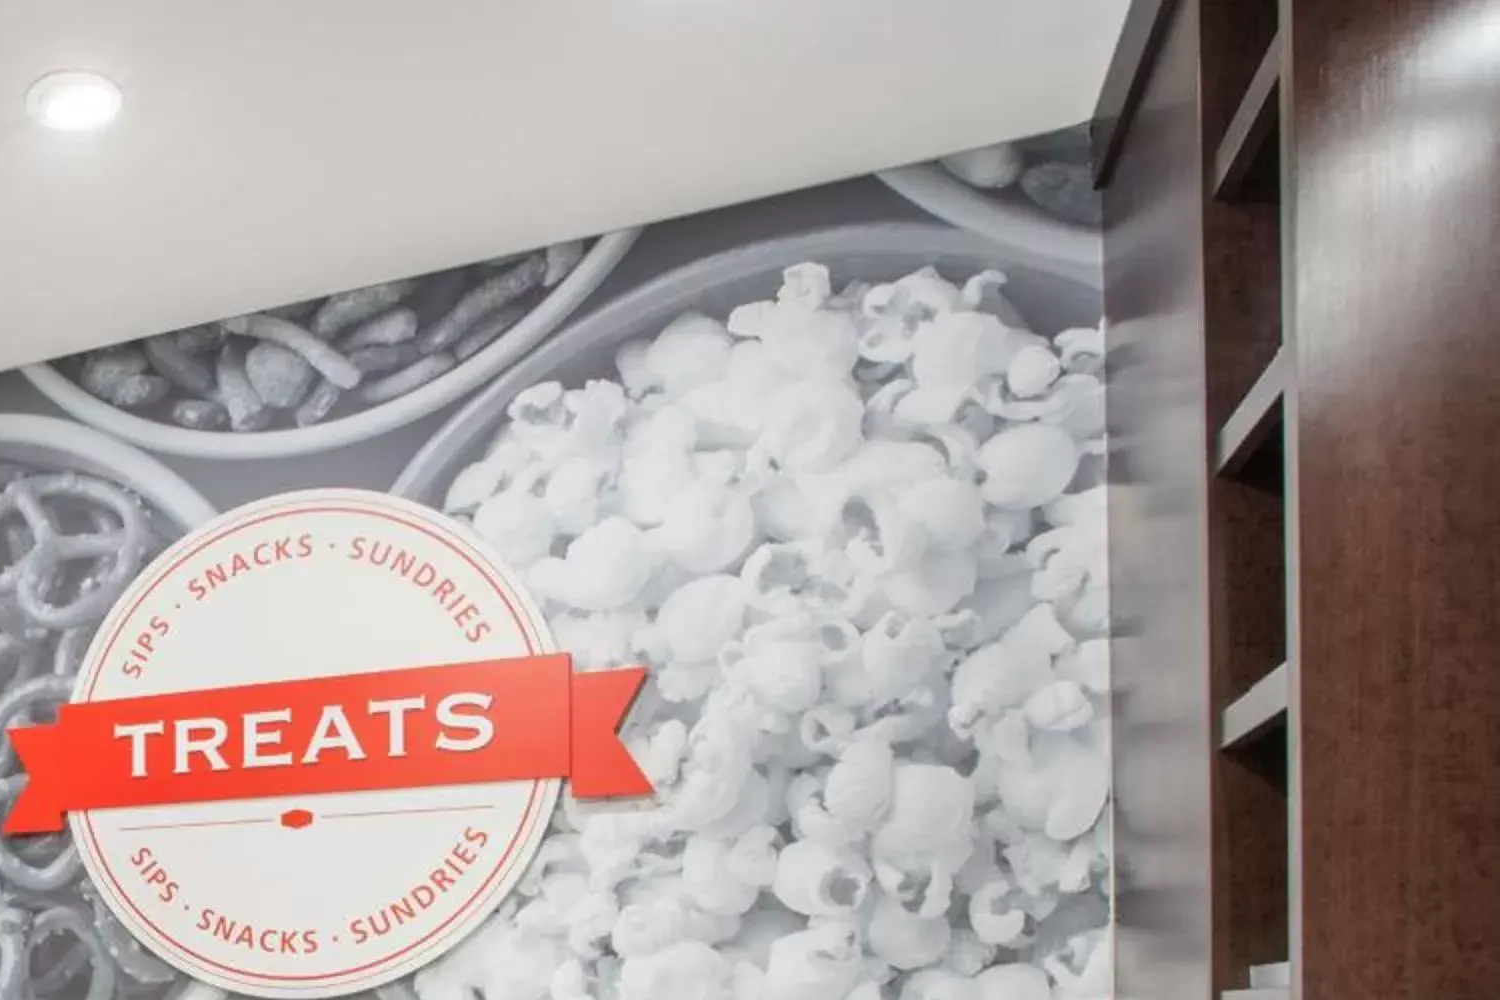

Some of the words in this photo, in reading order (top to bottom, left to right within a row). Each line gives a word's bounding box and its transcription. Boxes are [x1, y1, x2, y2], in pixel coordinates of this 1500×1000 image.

[122, 614, 171, 679] SIPS
[188, 533, 315, 602] SNACKS
[347, 535, 493, 645] SUNDRIES
[113, 691, 497, 778] TREATS
[129, 845, 178, 905] SIPS
[195, 907, 318, 955] SNACKS
[349, 824, 490, 945] SUNDRIES
